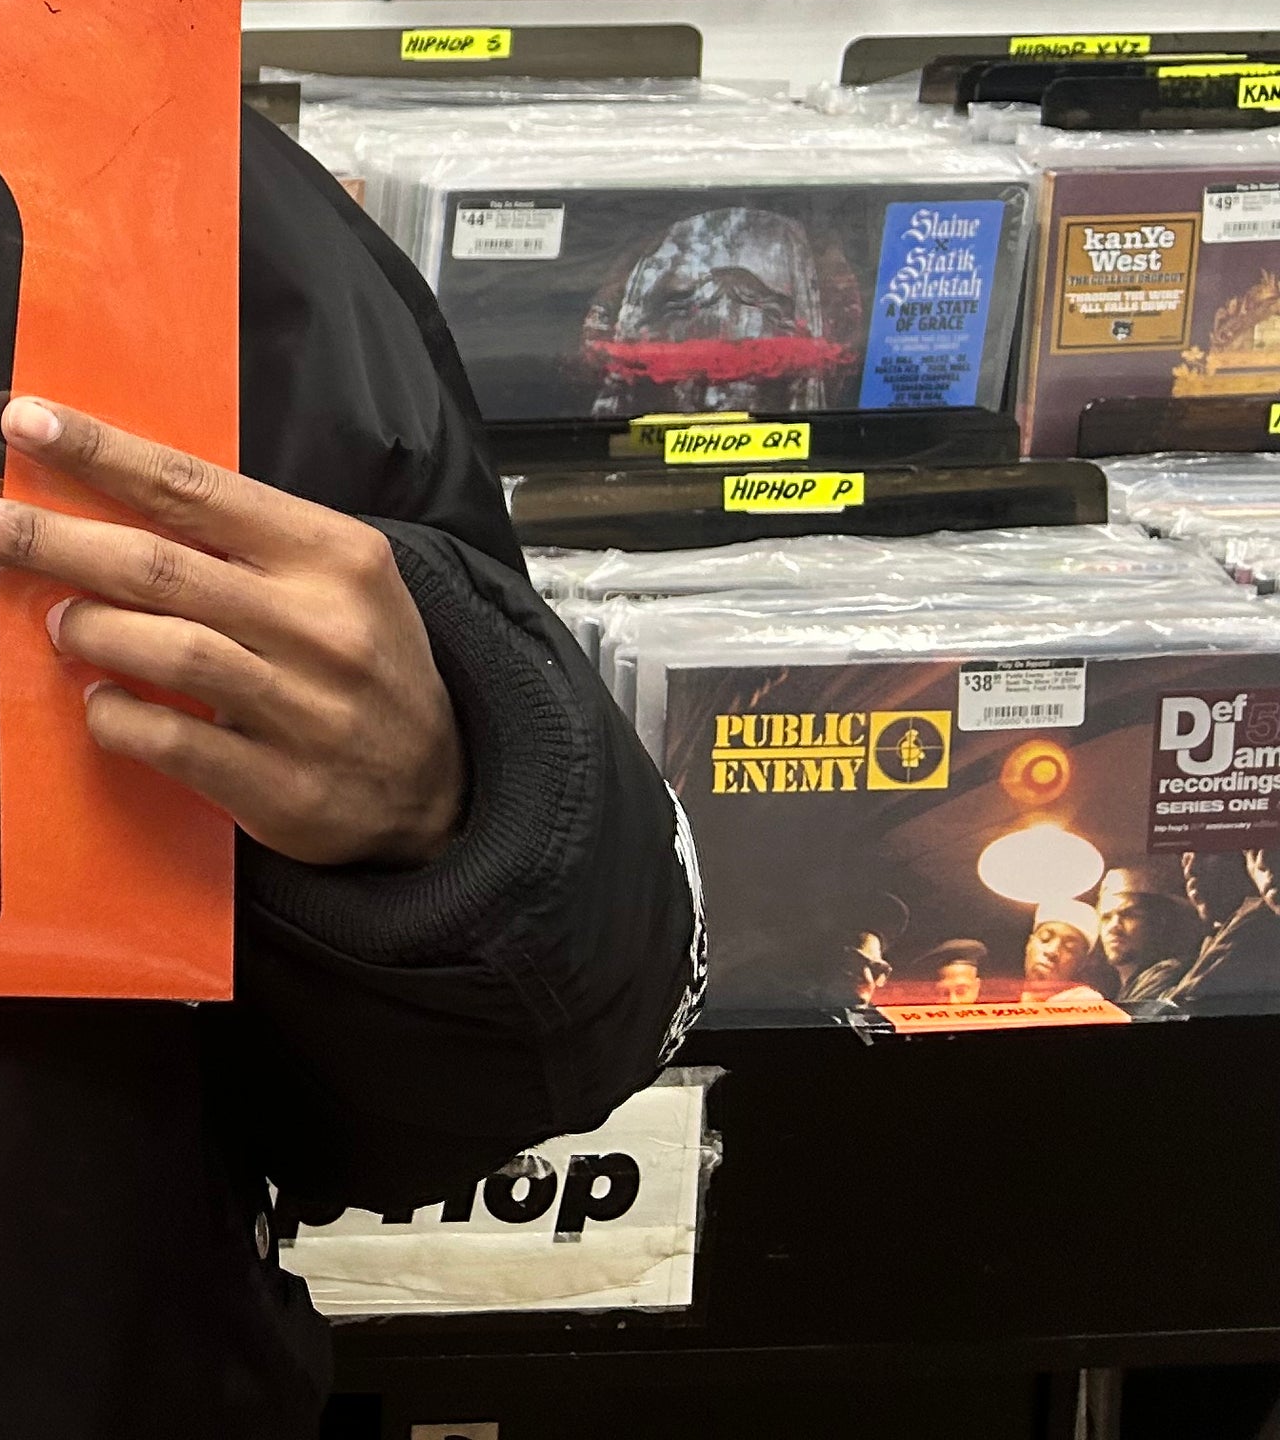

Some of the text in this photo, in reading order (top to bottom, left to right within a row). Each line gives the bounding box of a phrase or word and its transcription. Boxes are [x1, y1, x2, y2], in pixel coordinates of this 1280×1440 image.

[901, 209, 980, 242] Slaine
[896, 247, 975, 278] Statik
[1088, 249, 1162, 273] West
[885, 300, 980, 317] A NEW STATE
[895, 315, 965, 332] OF GRACE
[762, 429, 802, 449] QR
[832, 479, 853, 501] P
[964, 675, 992, 691] $38
[714, 713, 865, 747] PUBLIC
[1159, 693, 1248, 751] Def
[712, 758, 865, 794] ENEMY
[1158, 771, 1280, 795] recordings
[1156, 798, 1269, 814] SERIES ONE
[901, 1012, 921, 1021] DO
